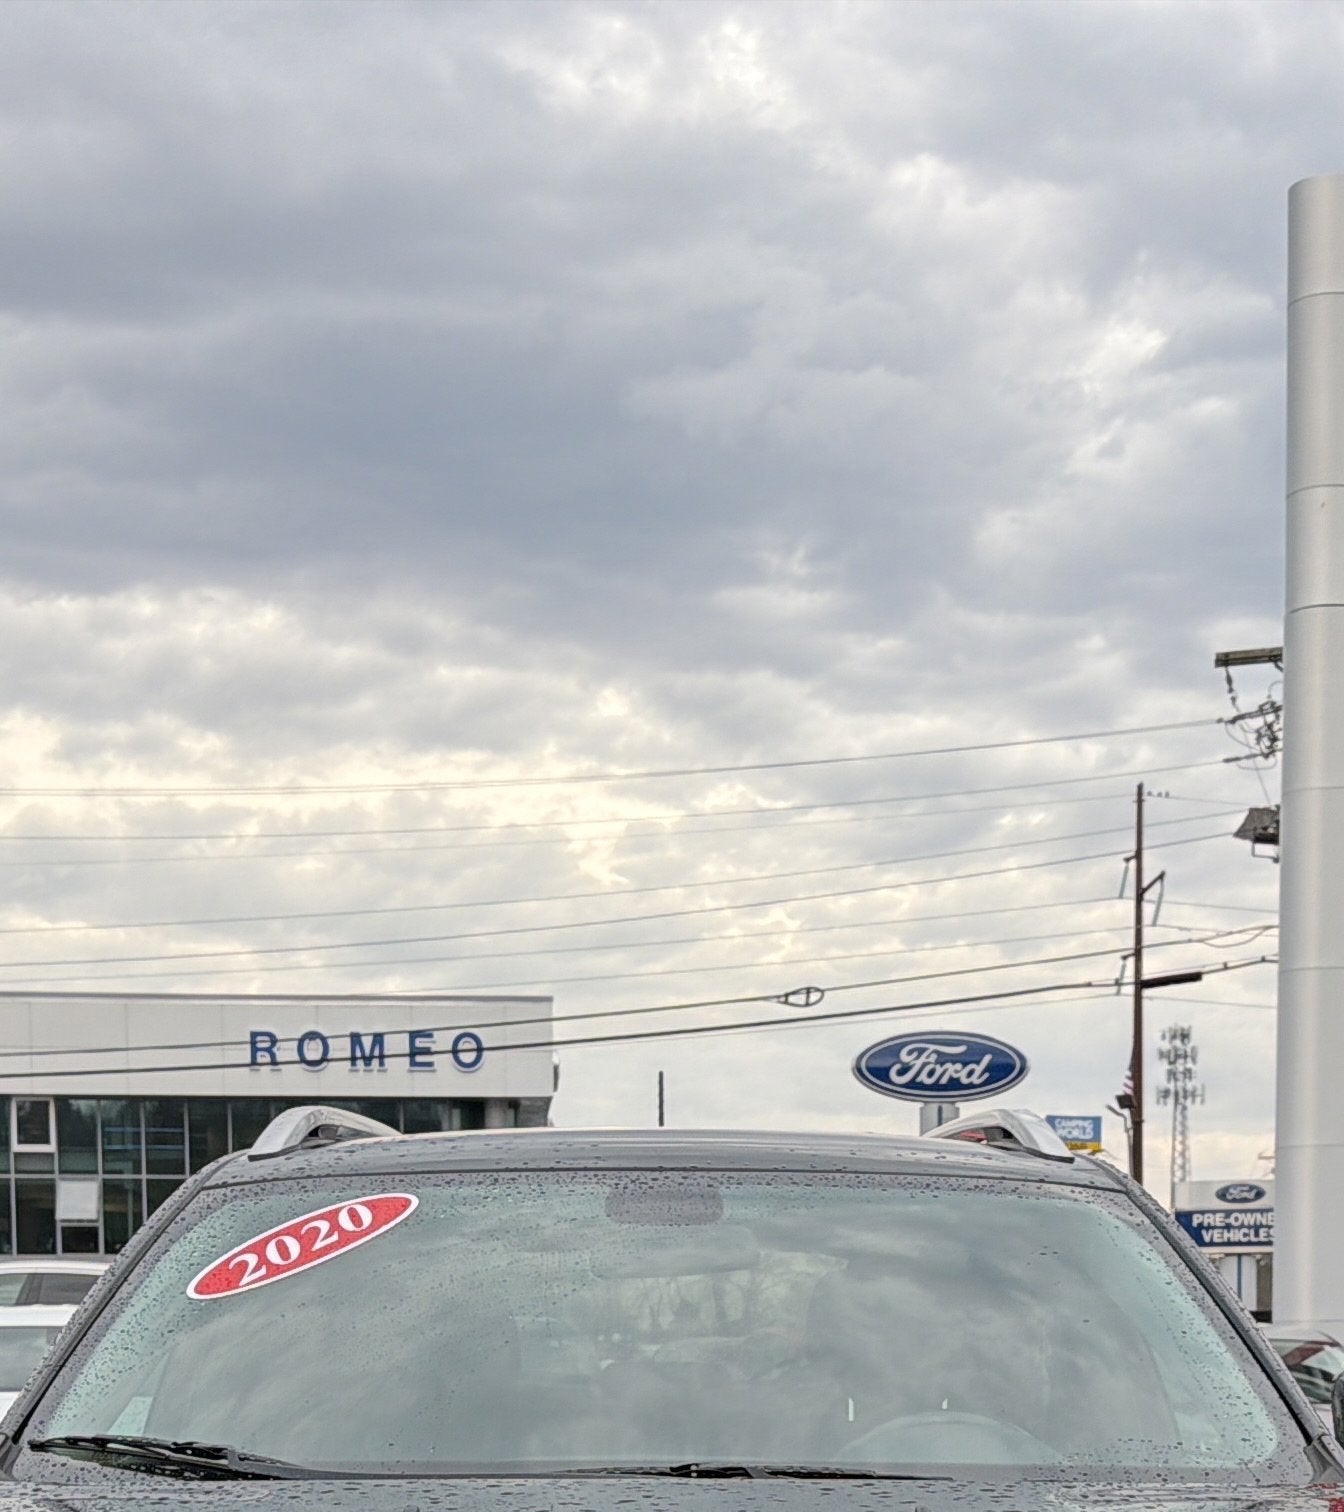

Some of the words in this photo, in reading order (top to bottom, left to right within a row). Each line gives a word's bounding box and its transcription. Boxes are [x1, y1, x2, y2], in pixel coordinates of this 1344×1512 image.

[250, 1030, 485, 1070] ROMEO
[888, 1042, 993, 1086] Ford
[1054, 1118, 1094, 1129] CAMPING
[1056, 1127, 1094, 1140] WORLD
[1225, 1185, 1258, 1200] Ford
[228, 1204, 374, 1287] 2020
